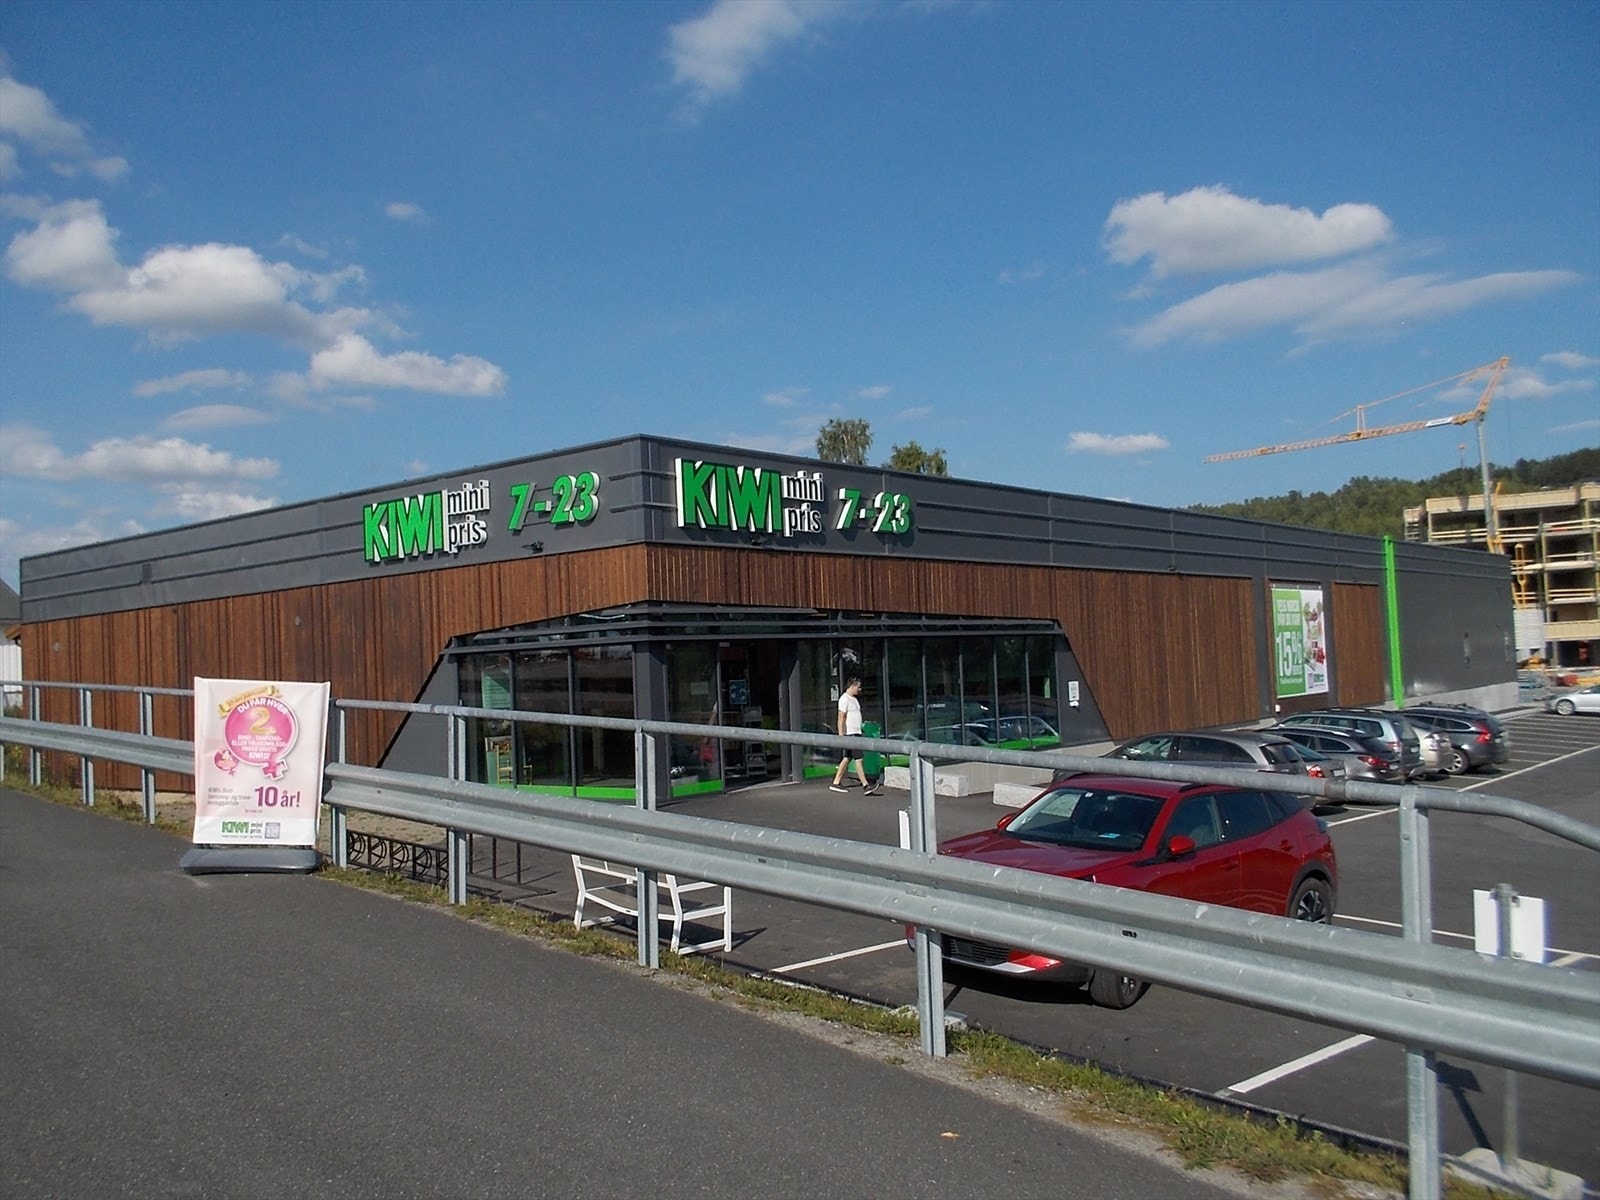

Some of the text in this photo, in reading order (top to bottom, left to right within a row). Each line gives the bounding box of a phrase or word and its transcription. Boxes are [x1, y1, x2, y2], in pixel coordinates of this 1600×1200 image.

[447, 480, 491, 515] mini
[508, 471, 601, 532] 7-23
[674, 457, 783, 533] KIWI
[782, 470, 824, 502] mini
[363, 490, 447, 562] KIWI
[783, 503, 822, 538] pris
[836, 487, 912, 534] 7-23
[448, 515, 488, 553] pris
[237, 702, 250, 714] DU
[266, 699, 289, 715] HVER
[254, 786, 301, 808] 10 år!
[222, 821, 249, 833] KIWI
[250, 827, 262, 835] pris
